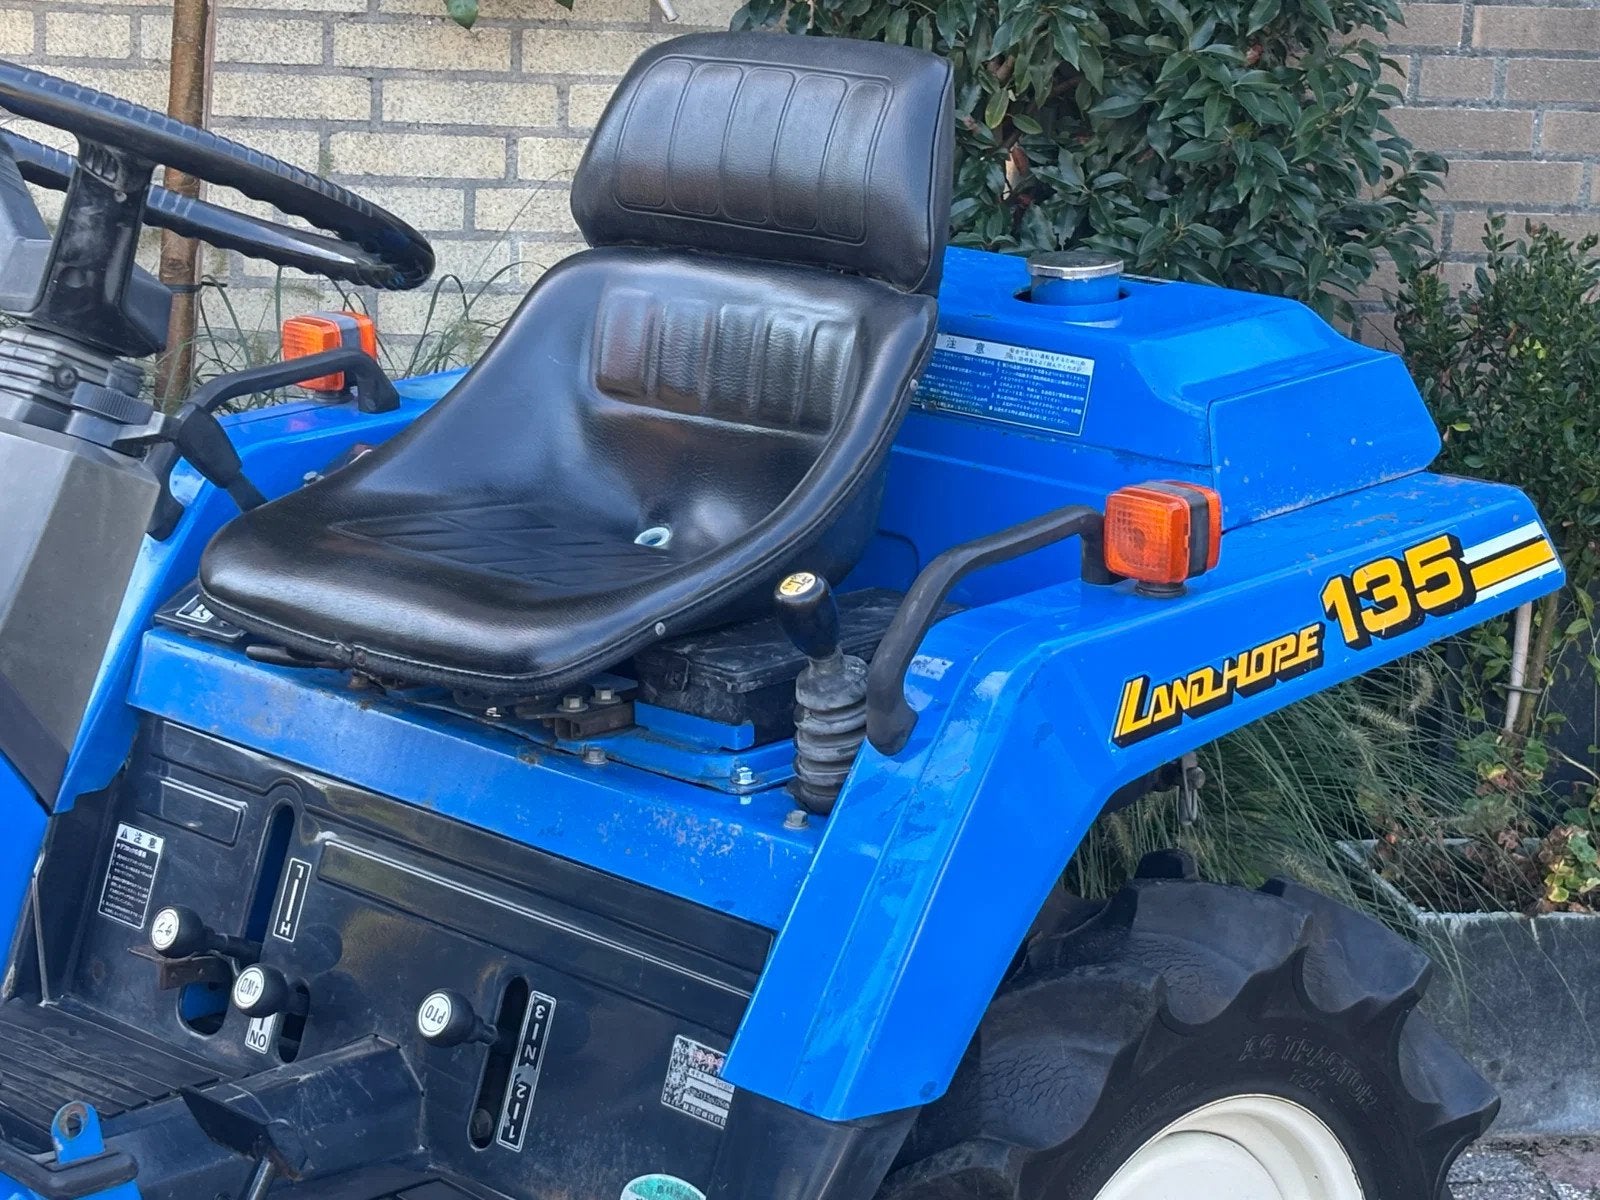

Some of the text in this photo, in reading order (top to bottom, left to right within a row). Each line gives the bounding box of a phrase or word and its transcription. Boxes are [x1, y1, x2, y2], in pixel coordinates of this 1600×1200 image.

[1112, 533, 1474, 746] LANDHOPE 135
[280, 921, 291, 936] H
[425, 1002, 447, 1024] PTO
[535, 1004, 546, 1019] 3
[249, 1029, 267, 1048] ON
[524, 1044, 537, 1060] N
[516, 1084, 527, 1098] 2
